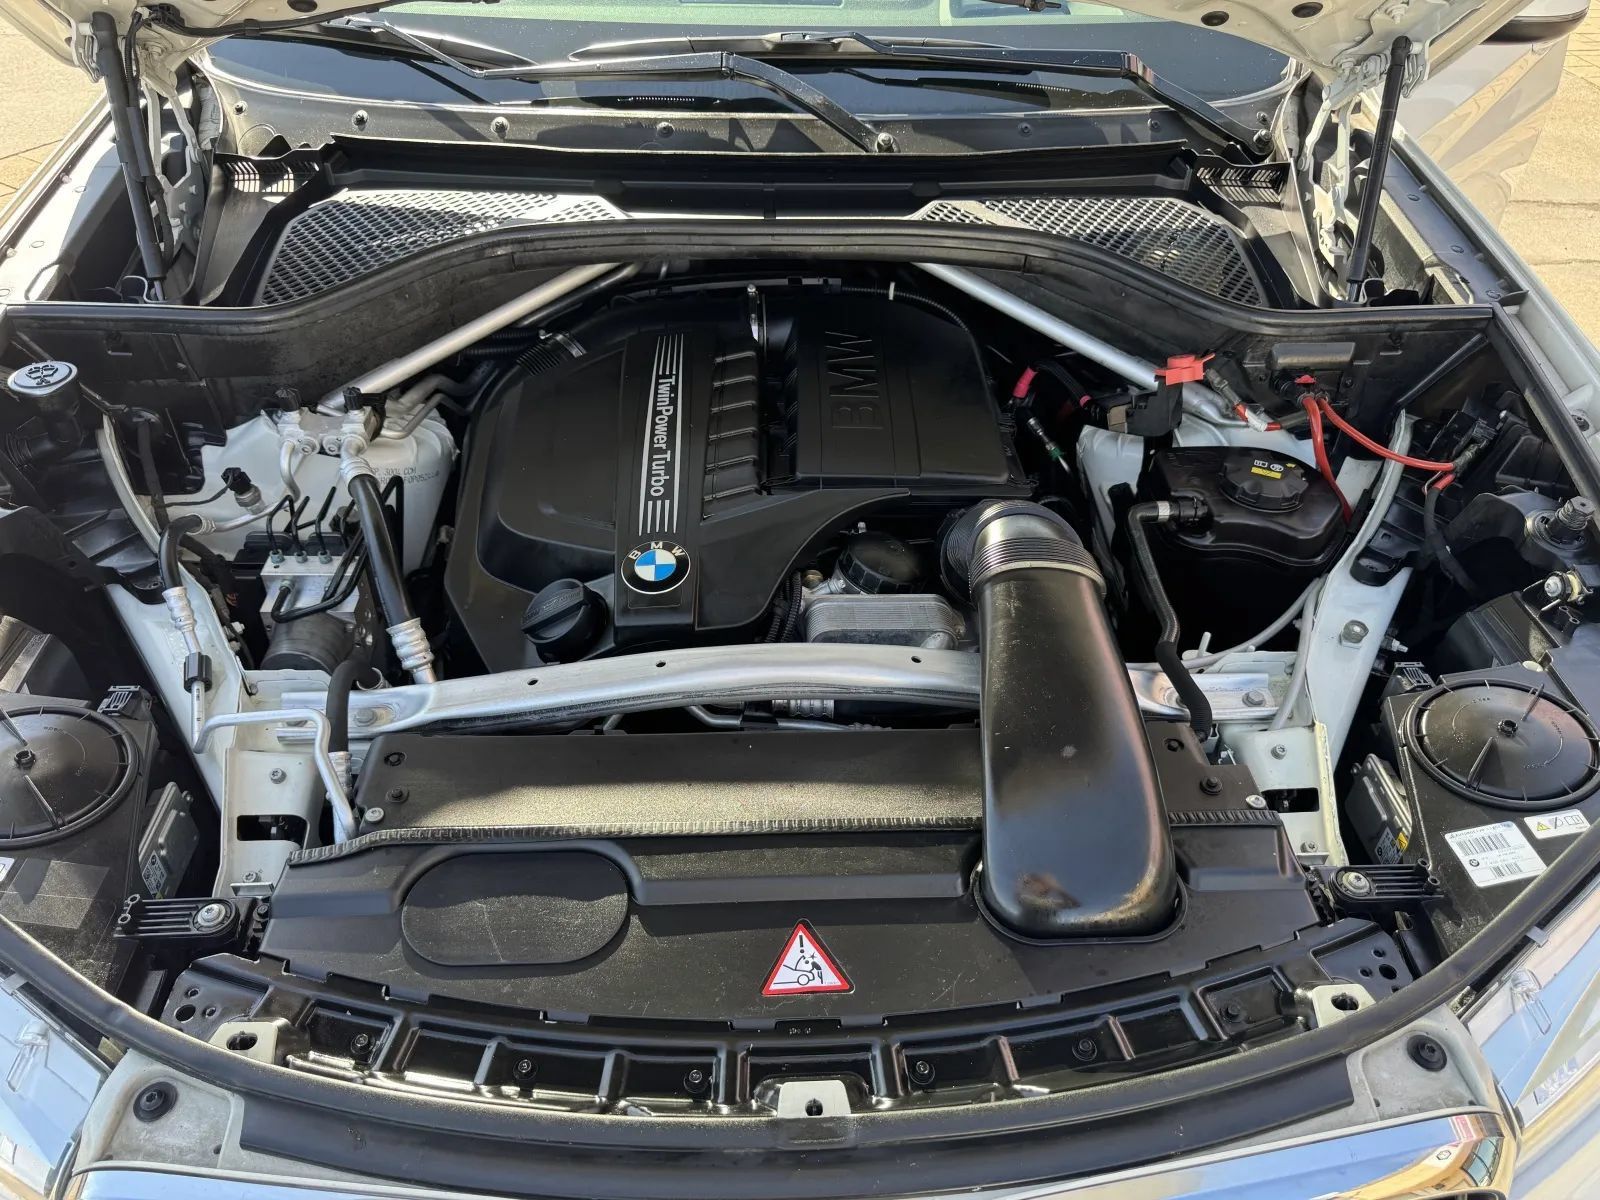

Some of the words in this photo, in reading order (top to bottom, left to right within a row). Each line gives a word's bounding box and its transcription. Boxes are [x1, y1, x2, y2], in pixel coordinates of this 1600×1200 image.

[825, 331, 883, 429] BMW
[653, 375, 676, 449] TwinPower
[650, 450, 671, 497] Turbo
[628, 541, 686, 560] BMW
